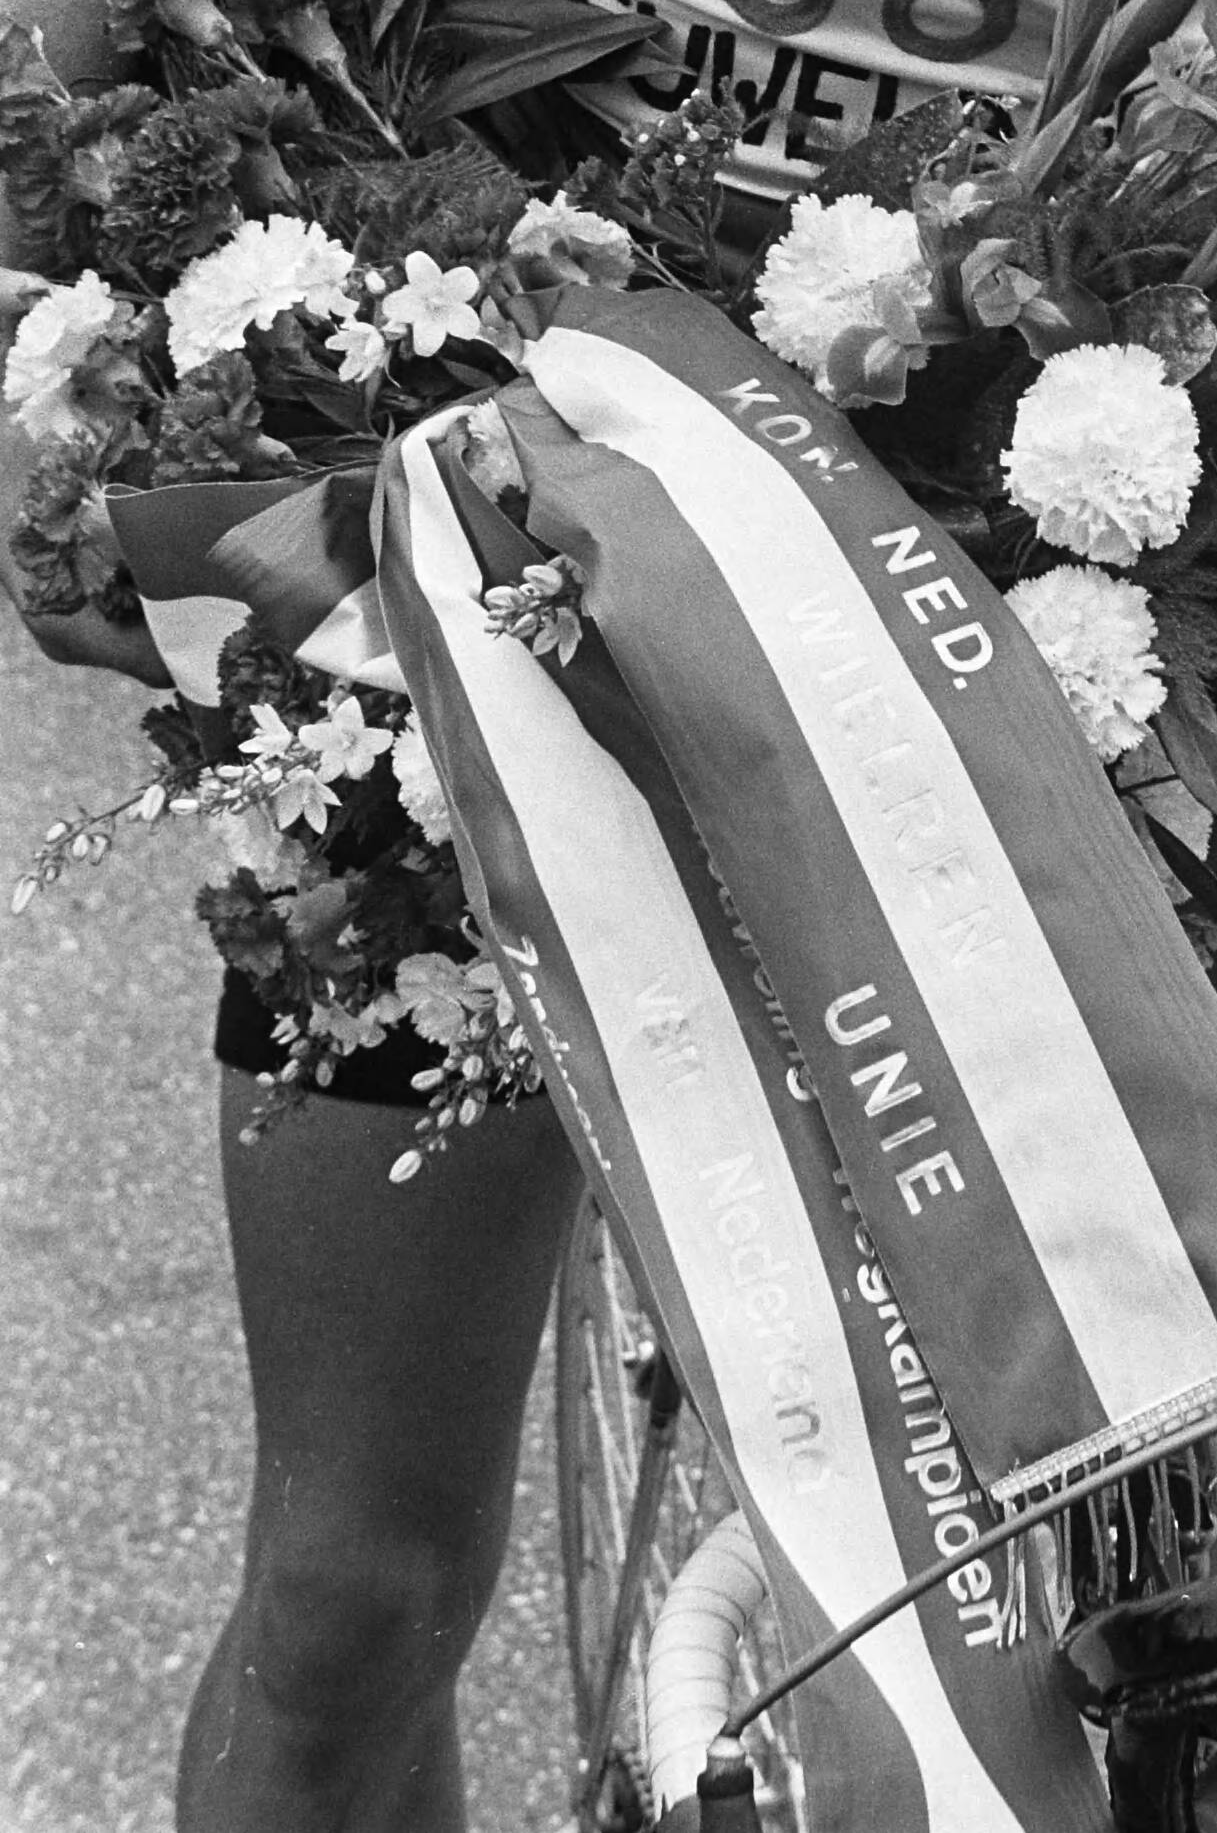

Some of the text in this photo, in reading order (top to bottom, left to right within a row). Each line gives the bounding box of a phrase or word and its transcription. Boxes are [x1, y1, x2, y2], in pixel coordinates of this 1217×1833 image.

[871, 525, 993, 690] NED.
[787, 588, 1004, 964] WIELREN
[825, 983, 965, 1215] UNIE
[833, 1168, 1001, 1647] gkampioen
